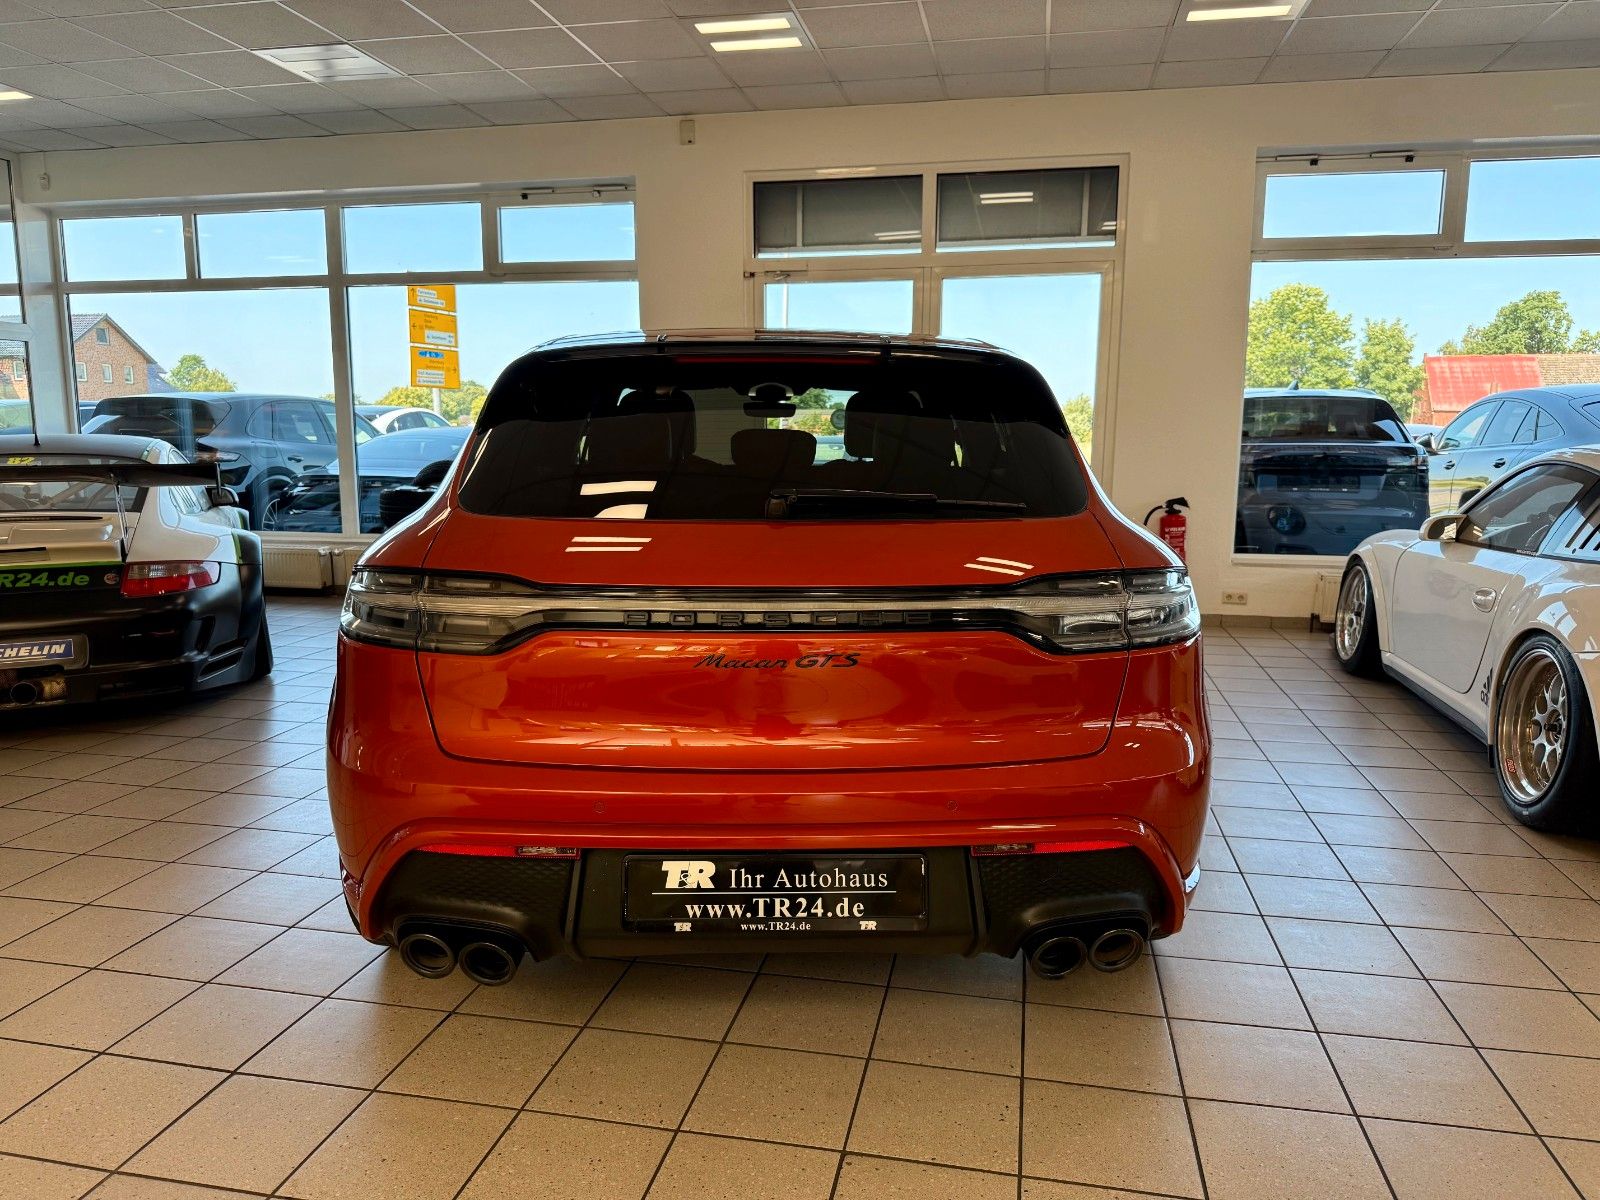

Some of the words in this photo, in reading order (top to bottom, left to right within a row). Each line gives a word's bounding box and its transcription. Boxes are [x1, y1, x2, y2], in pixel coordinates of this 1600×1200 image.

[0, 571, 90, 588] R24.de
[623, 610, 932, 628] PORSCHE
[693, 653, 788, 669] Macan
[794, 652, 861, 668] GTS
[729, 868, 767, 888] Ihr
[773, 867, 888, 888] Autohaus
[685, 897, 865, 918] www.TR24.de
[740, 921, 812, 931] www.TR24.de
